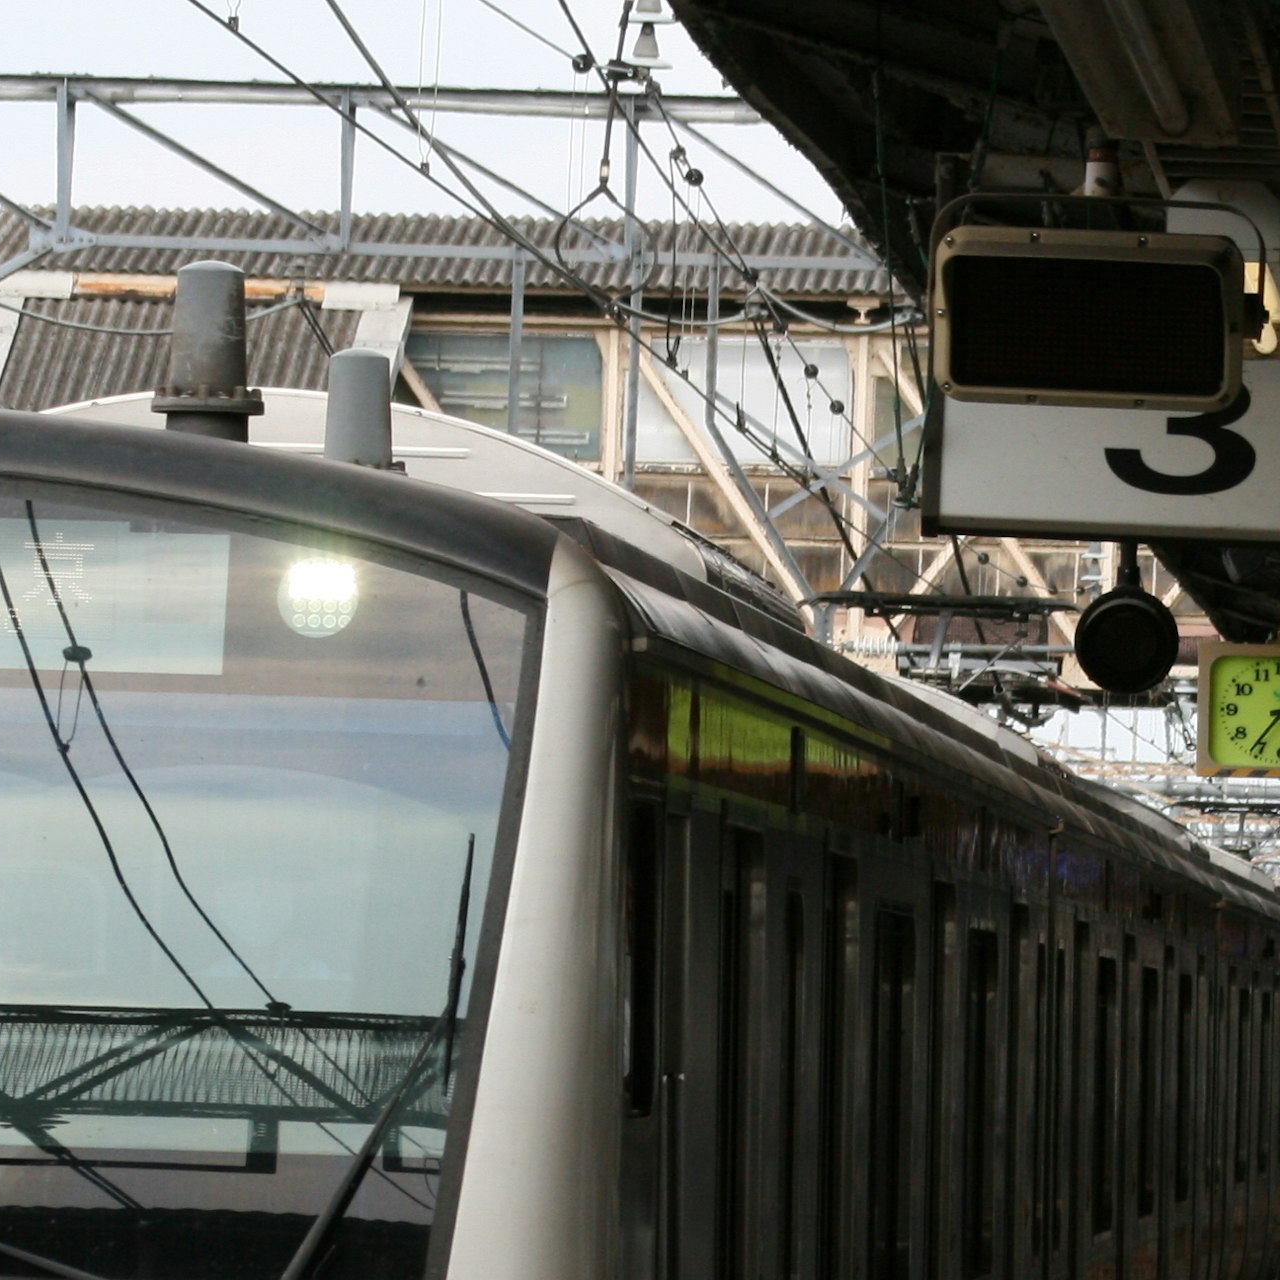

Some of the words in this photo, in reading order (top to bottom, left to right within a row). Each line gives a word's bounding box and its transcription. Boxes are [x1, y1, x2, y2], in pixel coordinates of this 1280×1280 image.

[1103, 384, 1257, 496] 3
[1254, 669, 1269, 682] 11
[1235, 683, 1253, 696] 10
[1226, 704, 1238, 716] 9
[1234, 726, 1247, 739] 8
